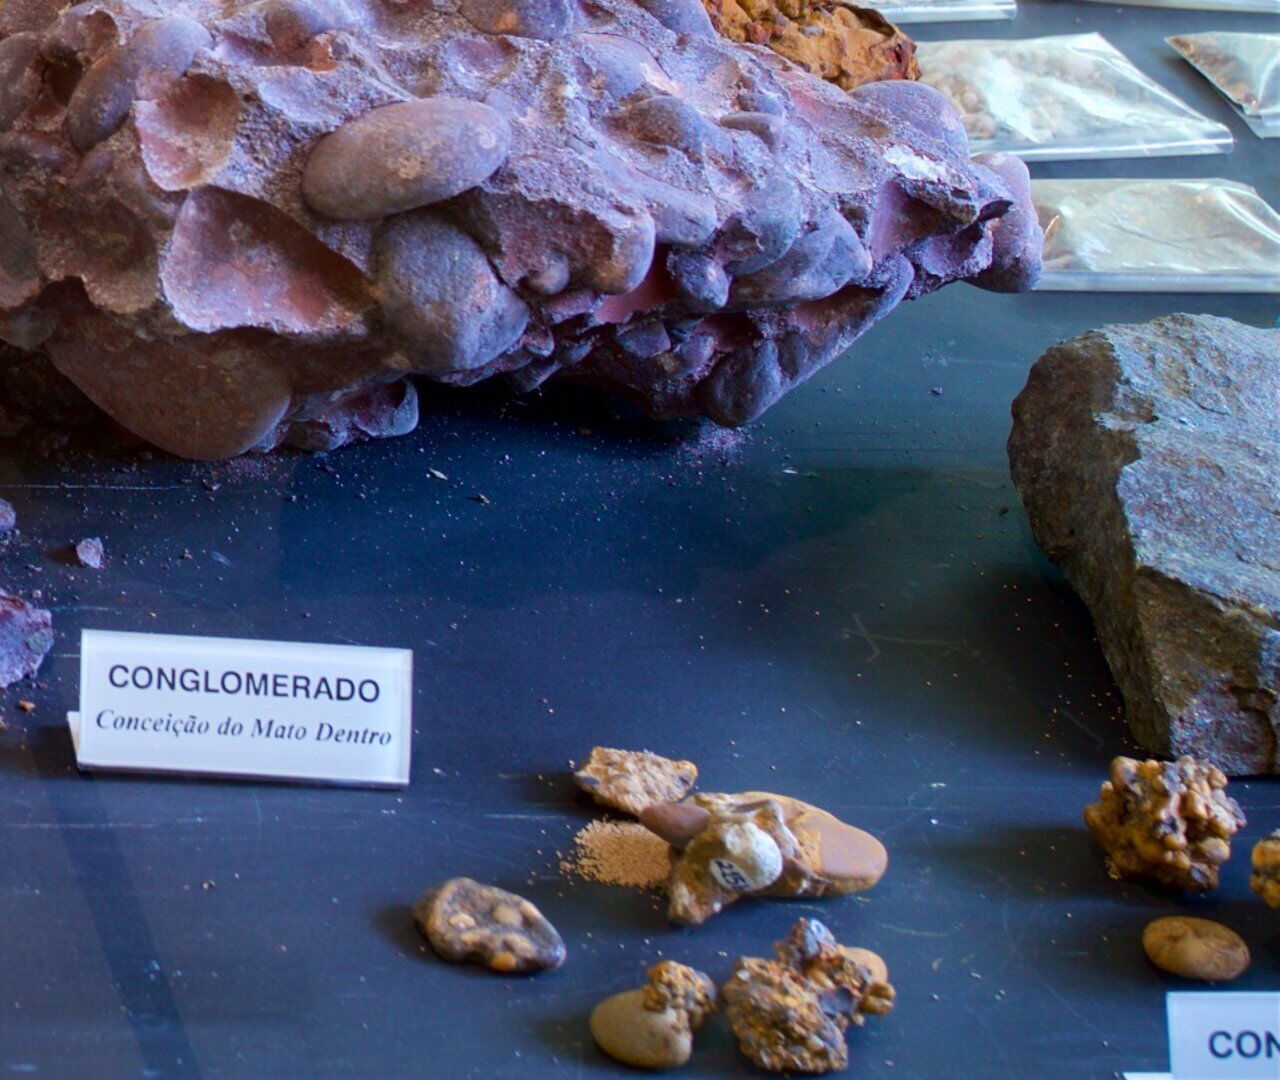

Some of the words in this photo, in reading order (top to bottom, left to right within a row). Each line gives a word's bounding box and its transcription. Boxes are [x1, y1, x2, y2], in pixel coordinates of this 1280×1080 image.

[108, 664, 381, 703] CONGLOMERADO
[95, 709, 210, 737] Conceição
[217, 716, 244, 737] do
[251, 719, 308, 741] Mato
[316, 722, 392, 747] Dentro
[1208, 1030, 1280, 1059] CON
